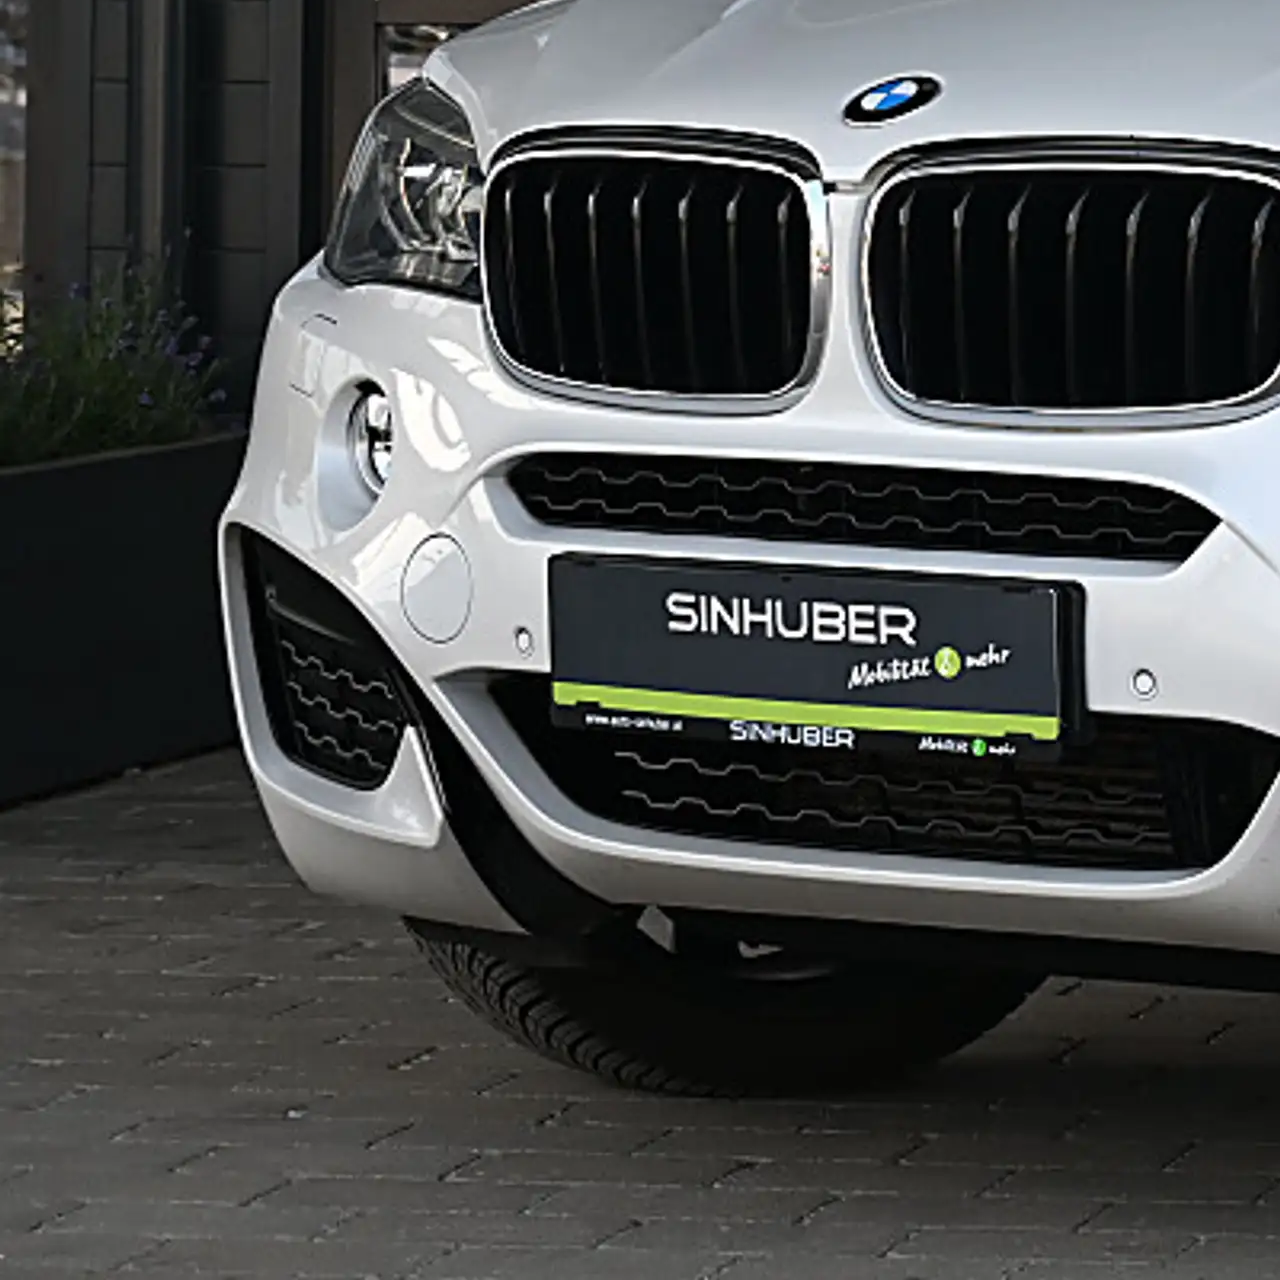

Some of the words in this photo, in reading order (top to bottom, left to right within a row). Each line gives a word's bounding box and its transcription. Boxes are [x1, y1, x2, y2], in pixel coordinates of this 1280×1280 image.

[665, 591, 917, 647] SINHUBER
[965, 642, 1011, 669] mehr
[729, 719, 855, 750] SINHUBER
